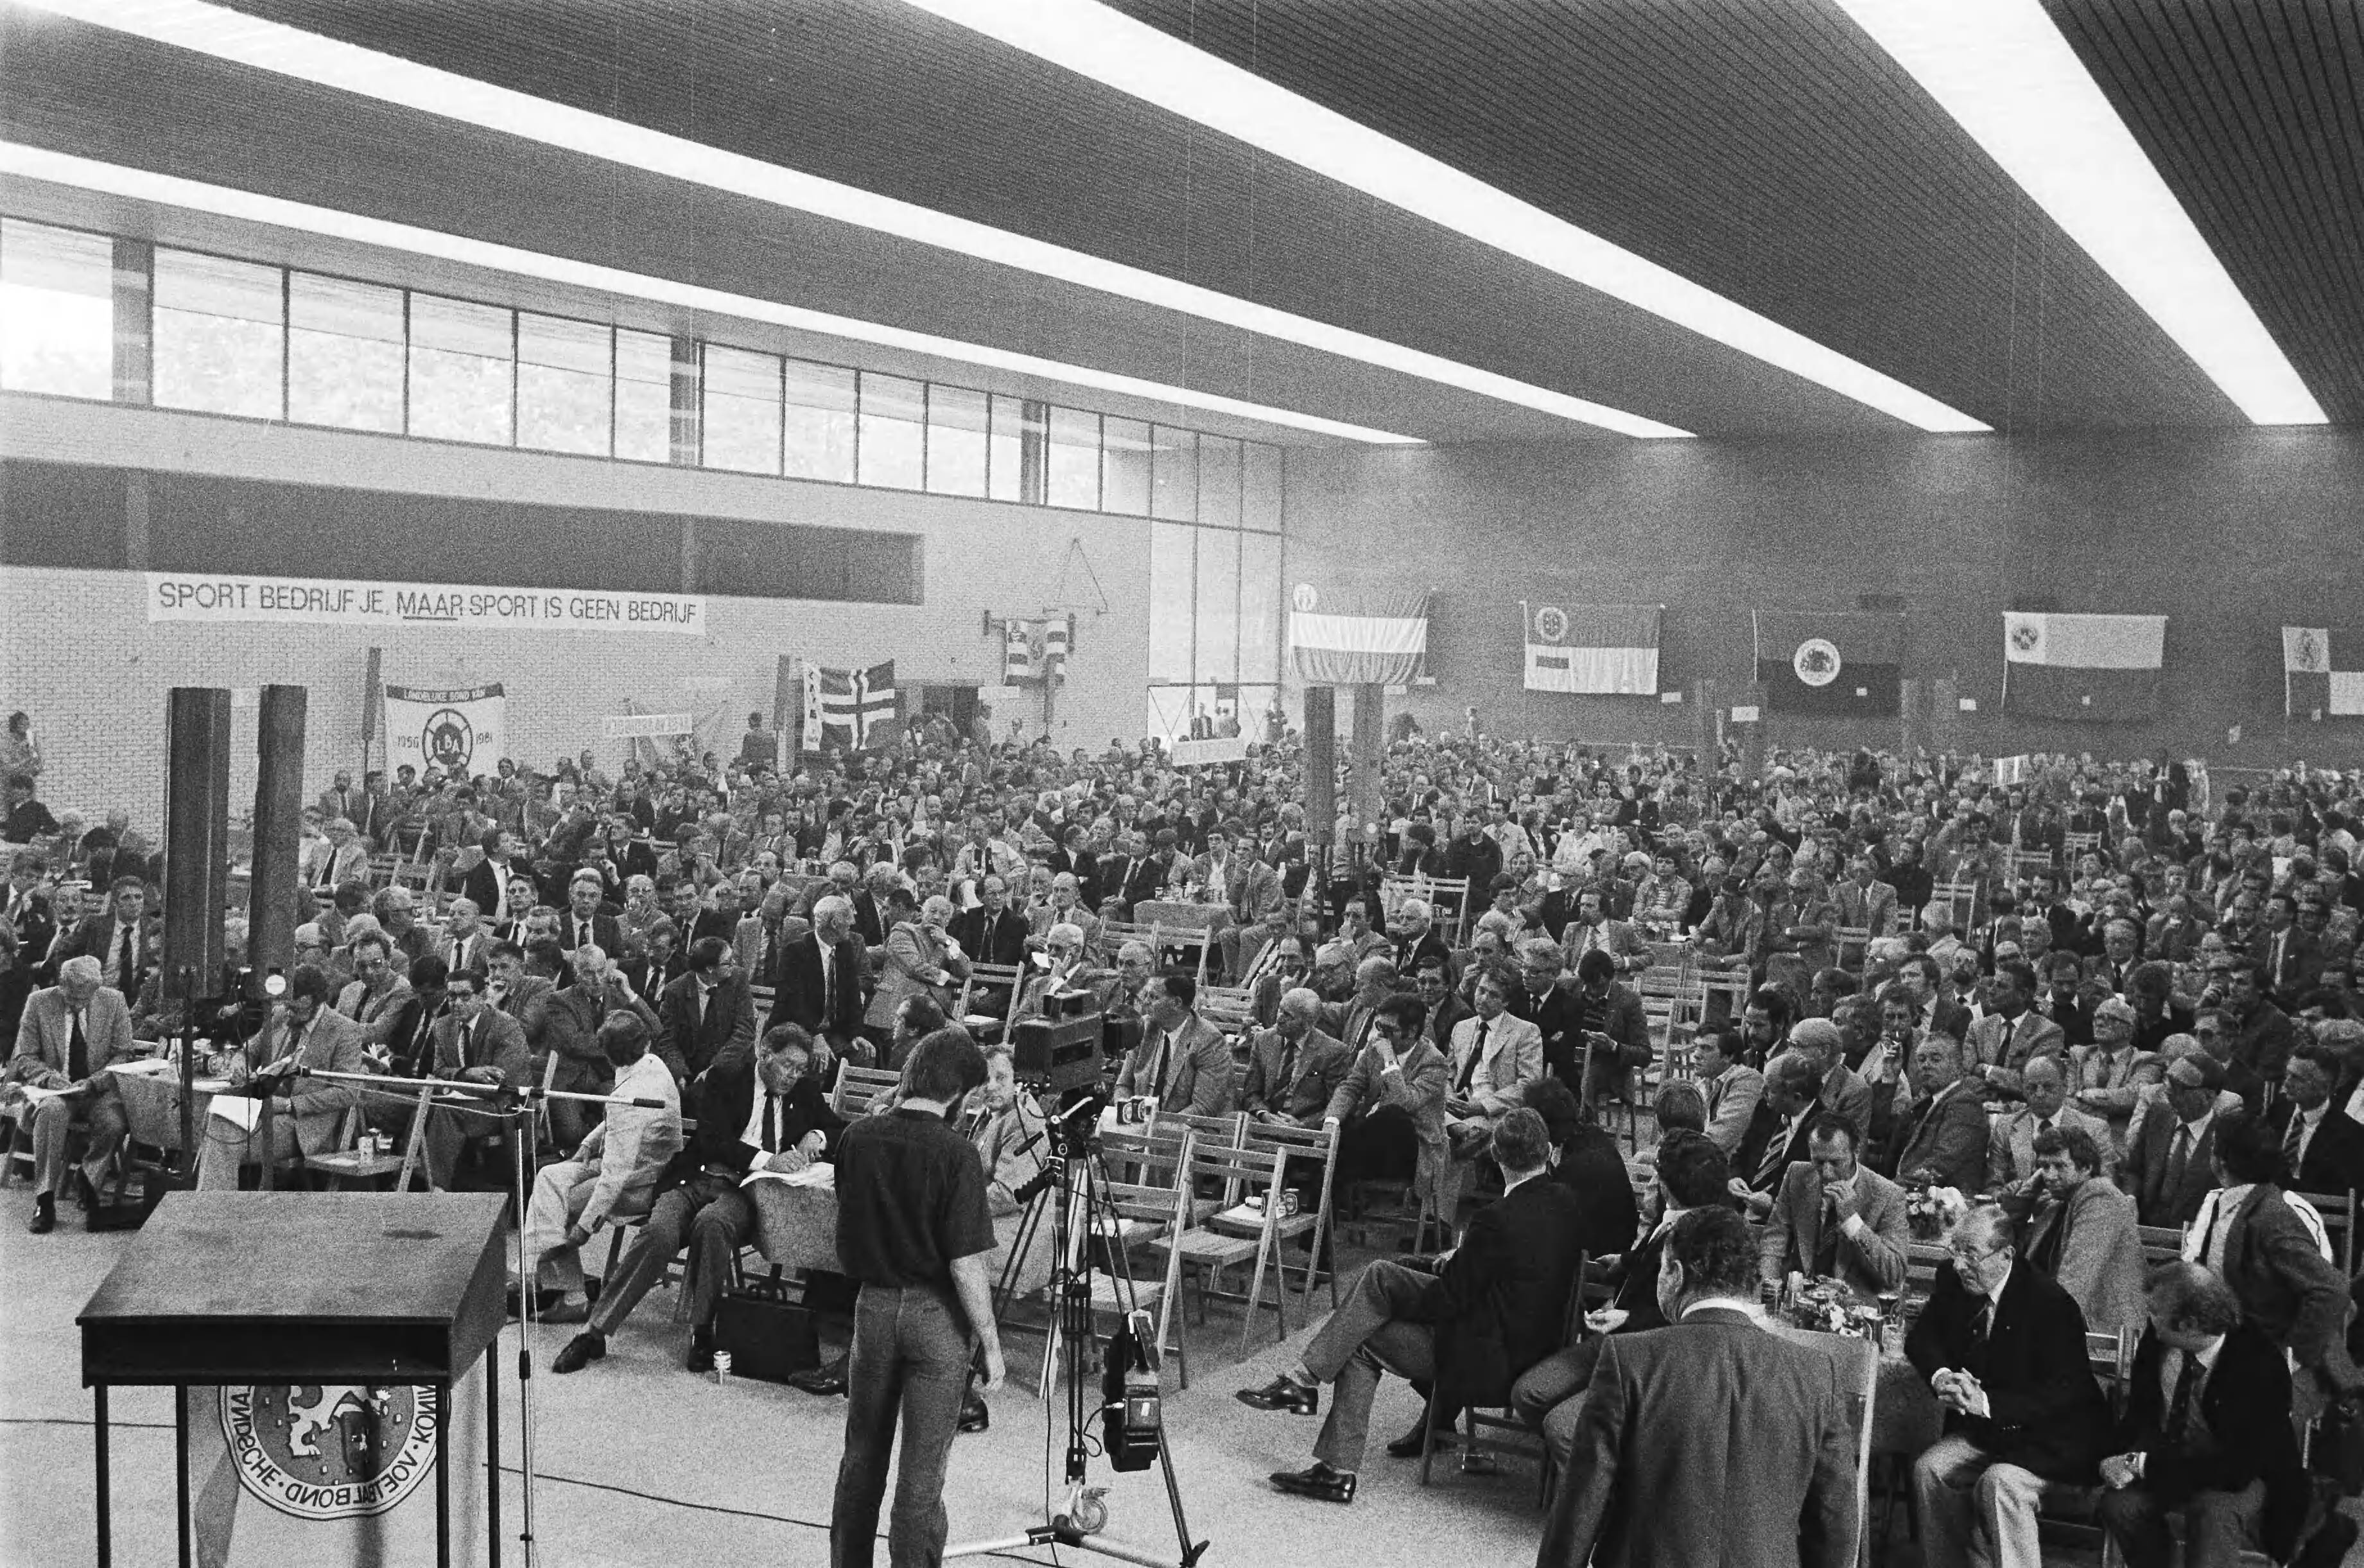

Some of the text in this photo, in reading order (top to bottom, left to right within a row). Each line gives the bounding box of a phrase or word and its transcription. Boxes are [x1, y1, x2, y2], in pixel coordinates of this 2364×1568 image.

[159, 582, 250, 608] SPORT
[259, 585, 354, 613] BEDRIJF
[396, 591, 463, 616] MAAR
[469, 595, 537, 618] SPORT
[545, 597, 562, 618] IS
[569, 598, 620, 620] GEEN
[629, 600, 697, 623] BEDRIJF
[476, 732, 493, 745] 1981
